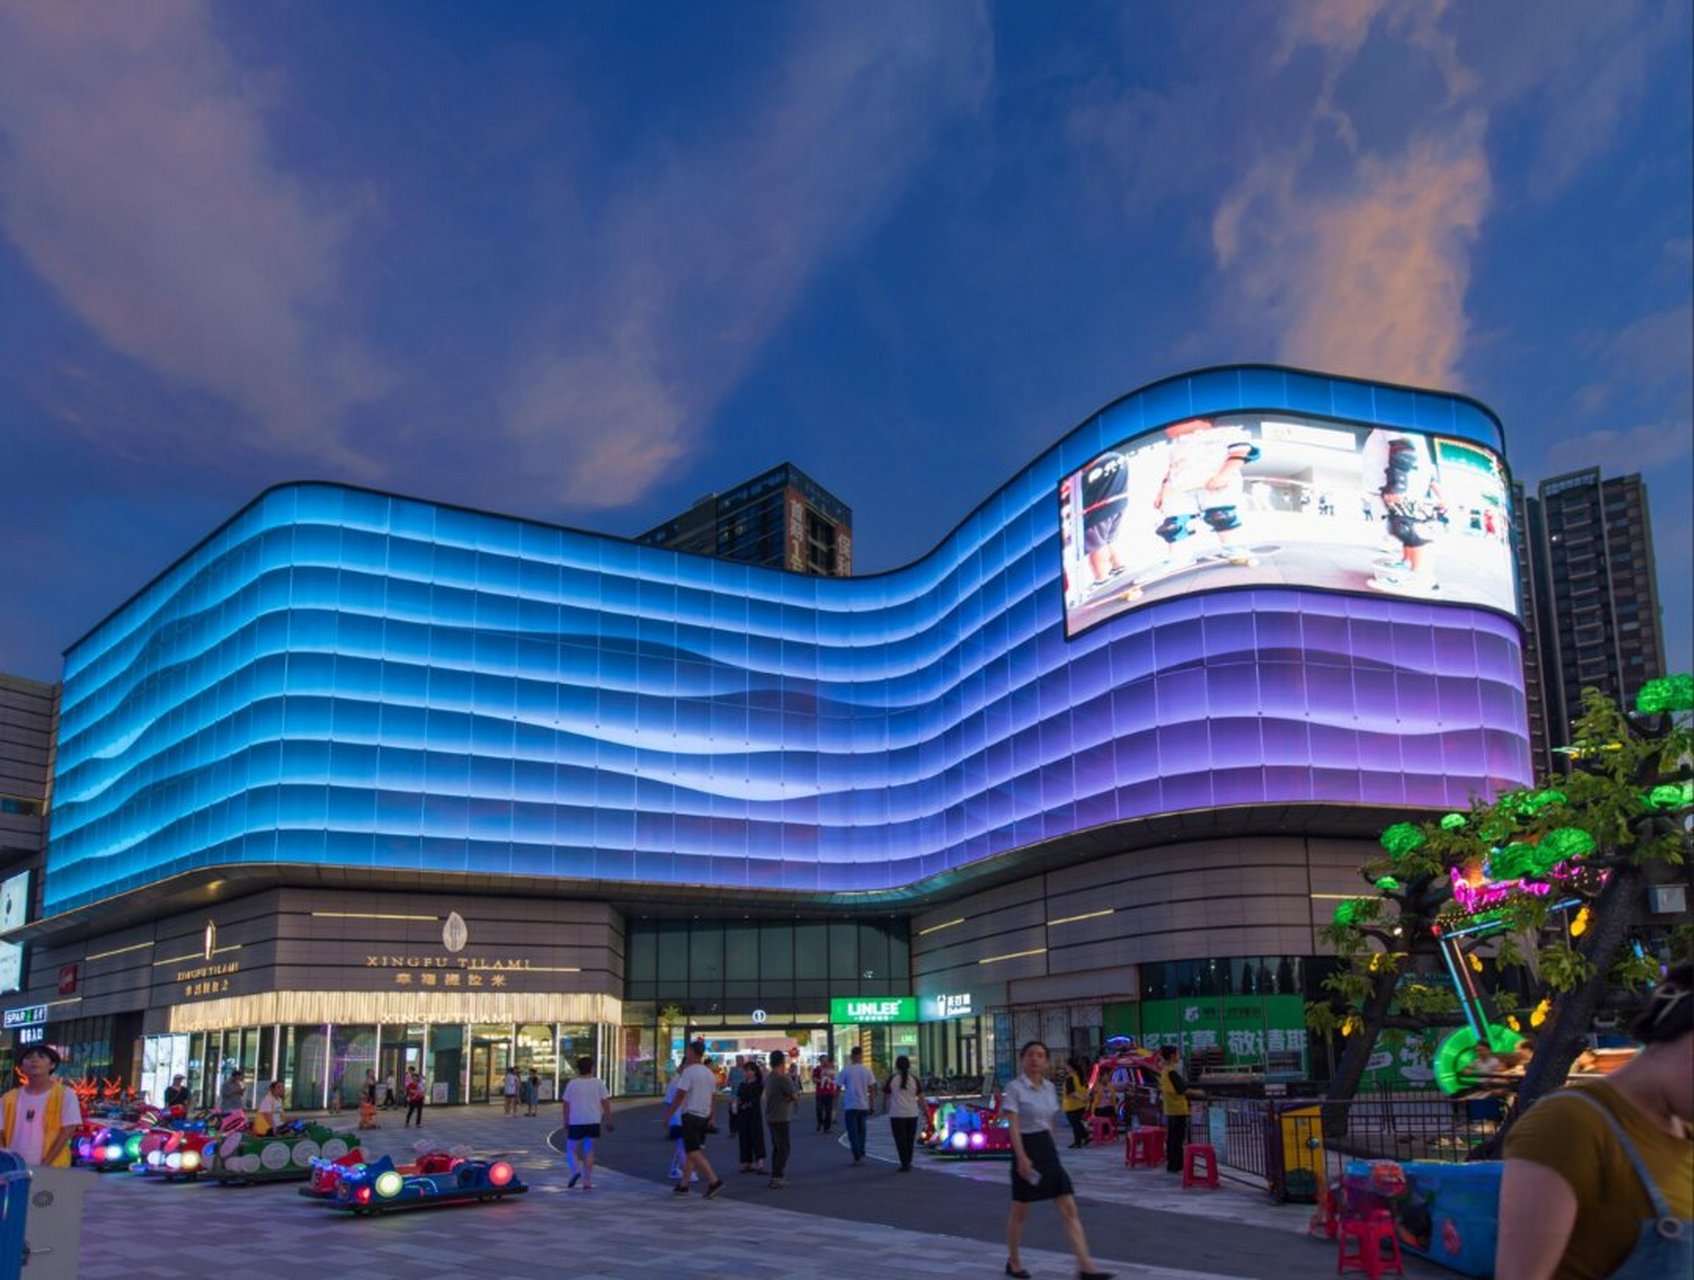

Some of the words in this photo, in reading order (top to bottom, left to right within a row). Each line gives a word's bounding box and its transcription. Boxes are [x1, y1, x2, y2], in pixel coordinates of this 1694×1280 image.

[366, 956, 448, 968] XINGFU
[457, 958, 530, 970] TILAMI
[848, 1002, 899, 1016] LINLEE
